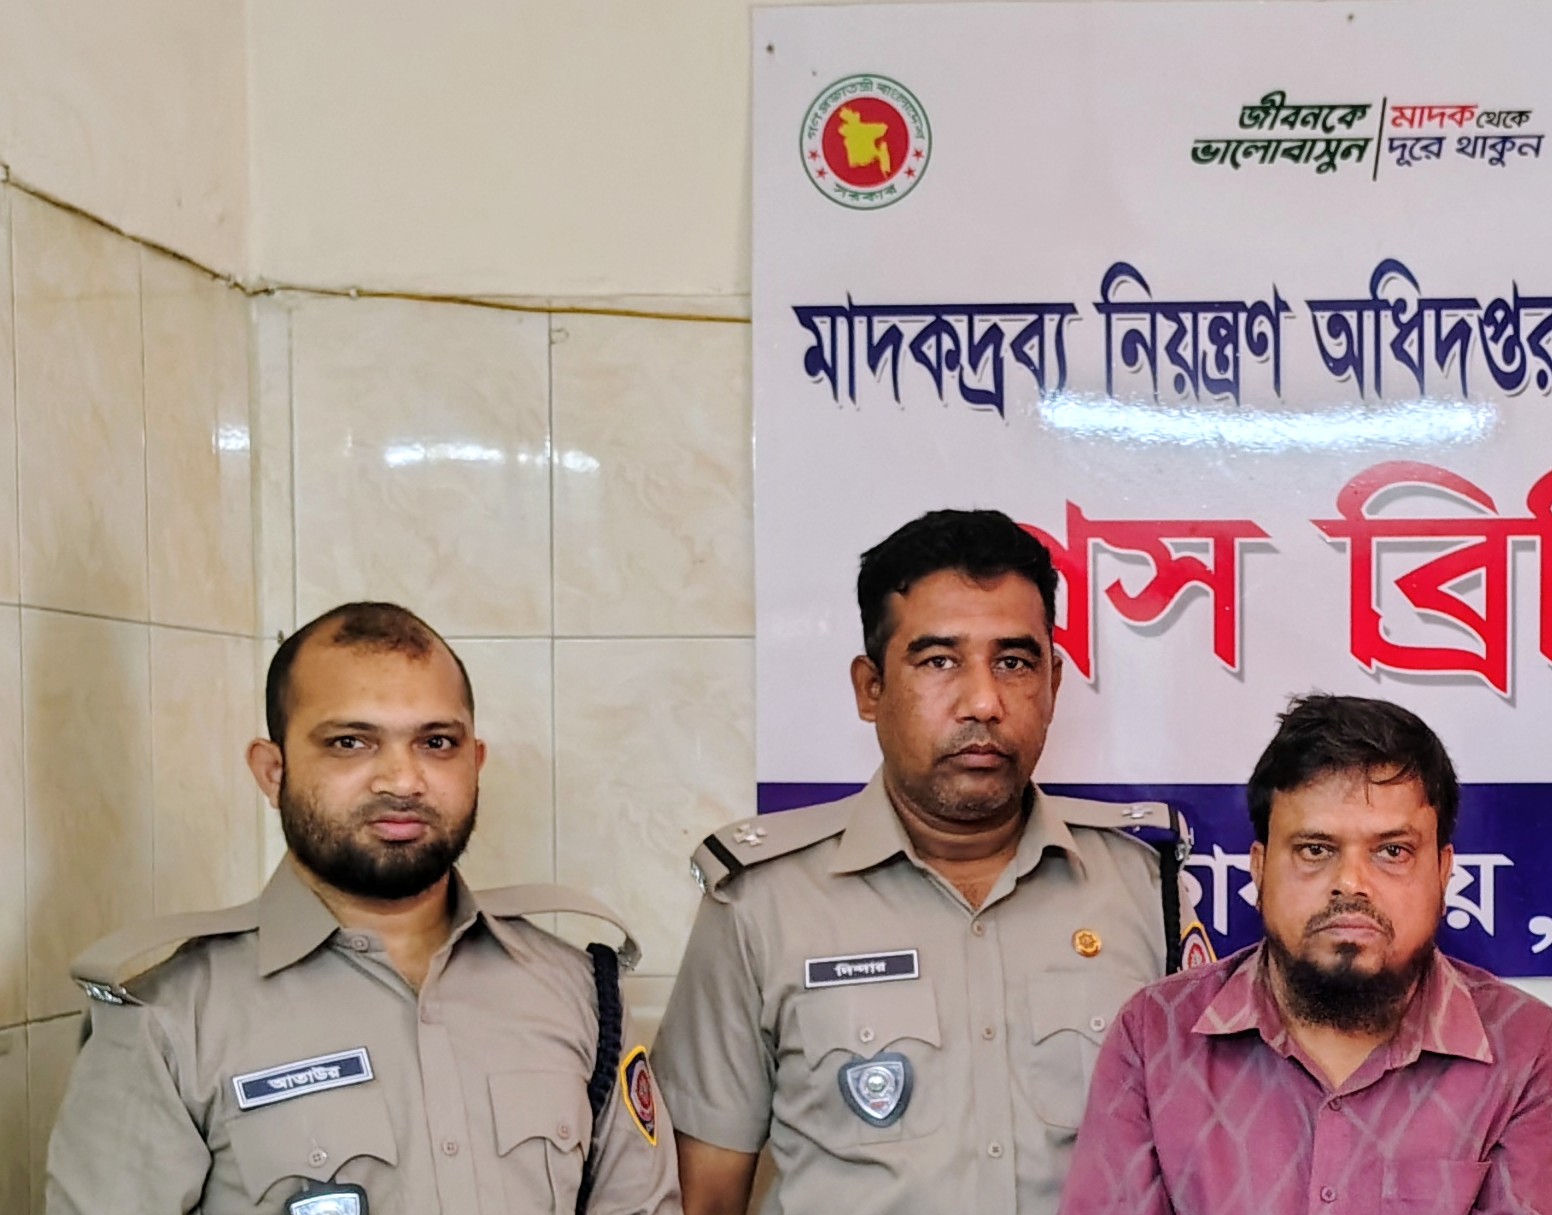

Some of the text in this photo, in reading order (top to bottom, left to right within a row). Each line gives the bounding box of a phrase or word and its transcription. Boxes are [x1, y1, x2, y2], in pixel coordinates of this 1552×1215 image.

[1238, 90, 1372, 134] জীবনকে
[1391, 104, 1533, 130] মাদক থেকে
[1190, 137, 1375, 174] ভালোবাসুন
[1387, 134, 1545, 167] দূরে থাকুন
[793, 291, 1079, 419] মাদকদ্রব্য
[1093, 261, 1291, 406] নিয়ন্ত্রণ
